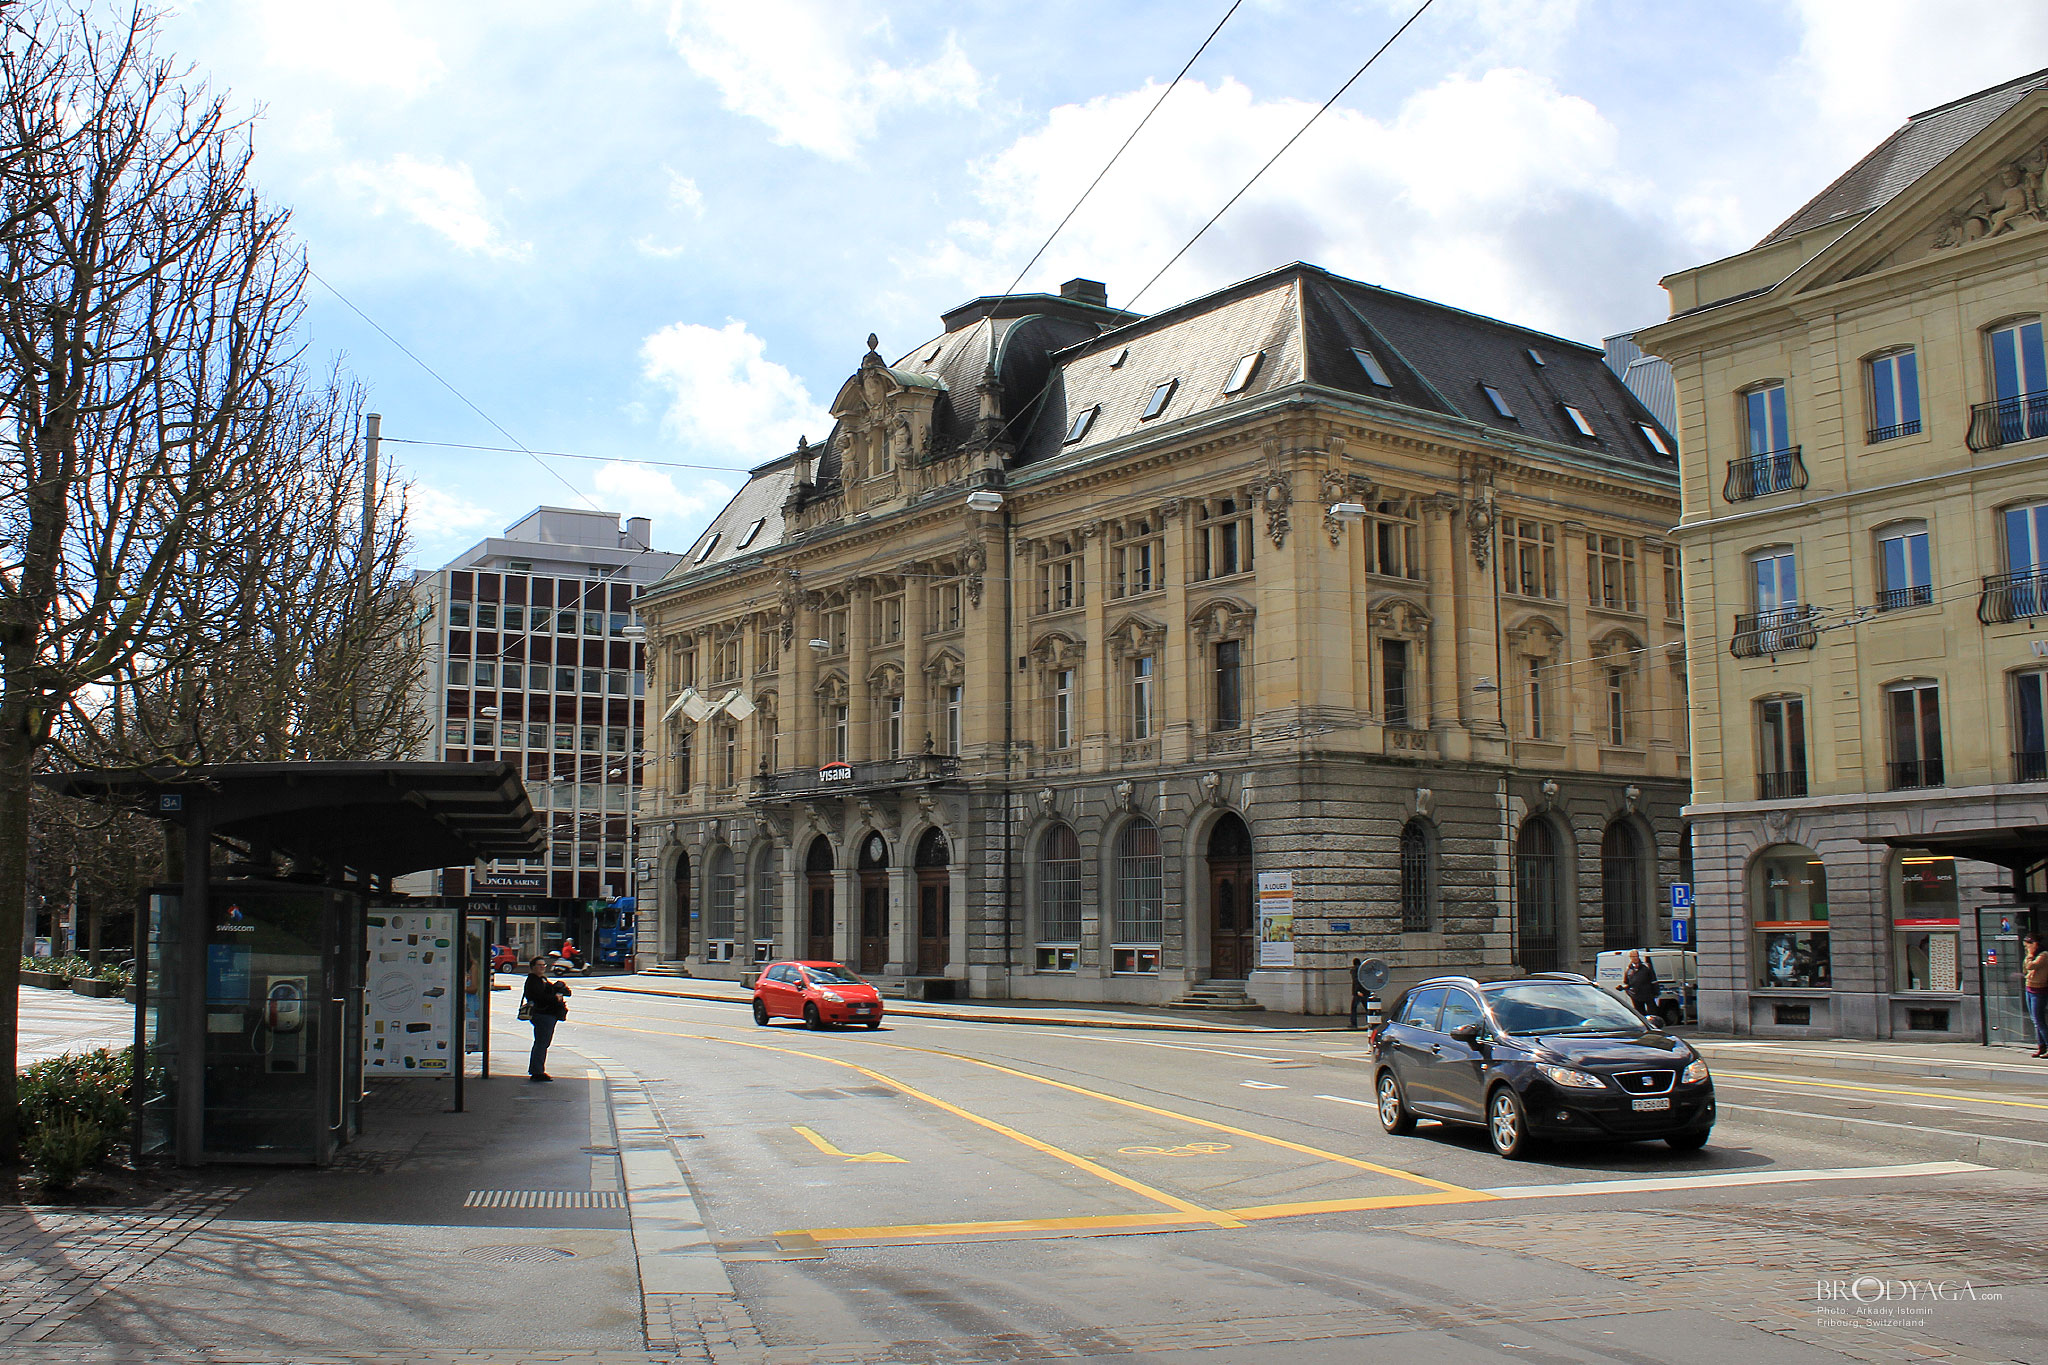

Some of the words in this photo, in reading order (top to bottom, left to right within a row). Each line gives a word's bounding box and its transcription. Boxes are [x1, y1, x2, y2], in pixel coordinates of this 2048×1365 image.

[480, 878, 512, 886] ONCIA
[1269, 882, 1287, 890] LOUER
[468, 902, 500, 911] FONCI
[508, 903, 538, 912] SARINE
[216, 923, 255, 932] swisscom
